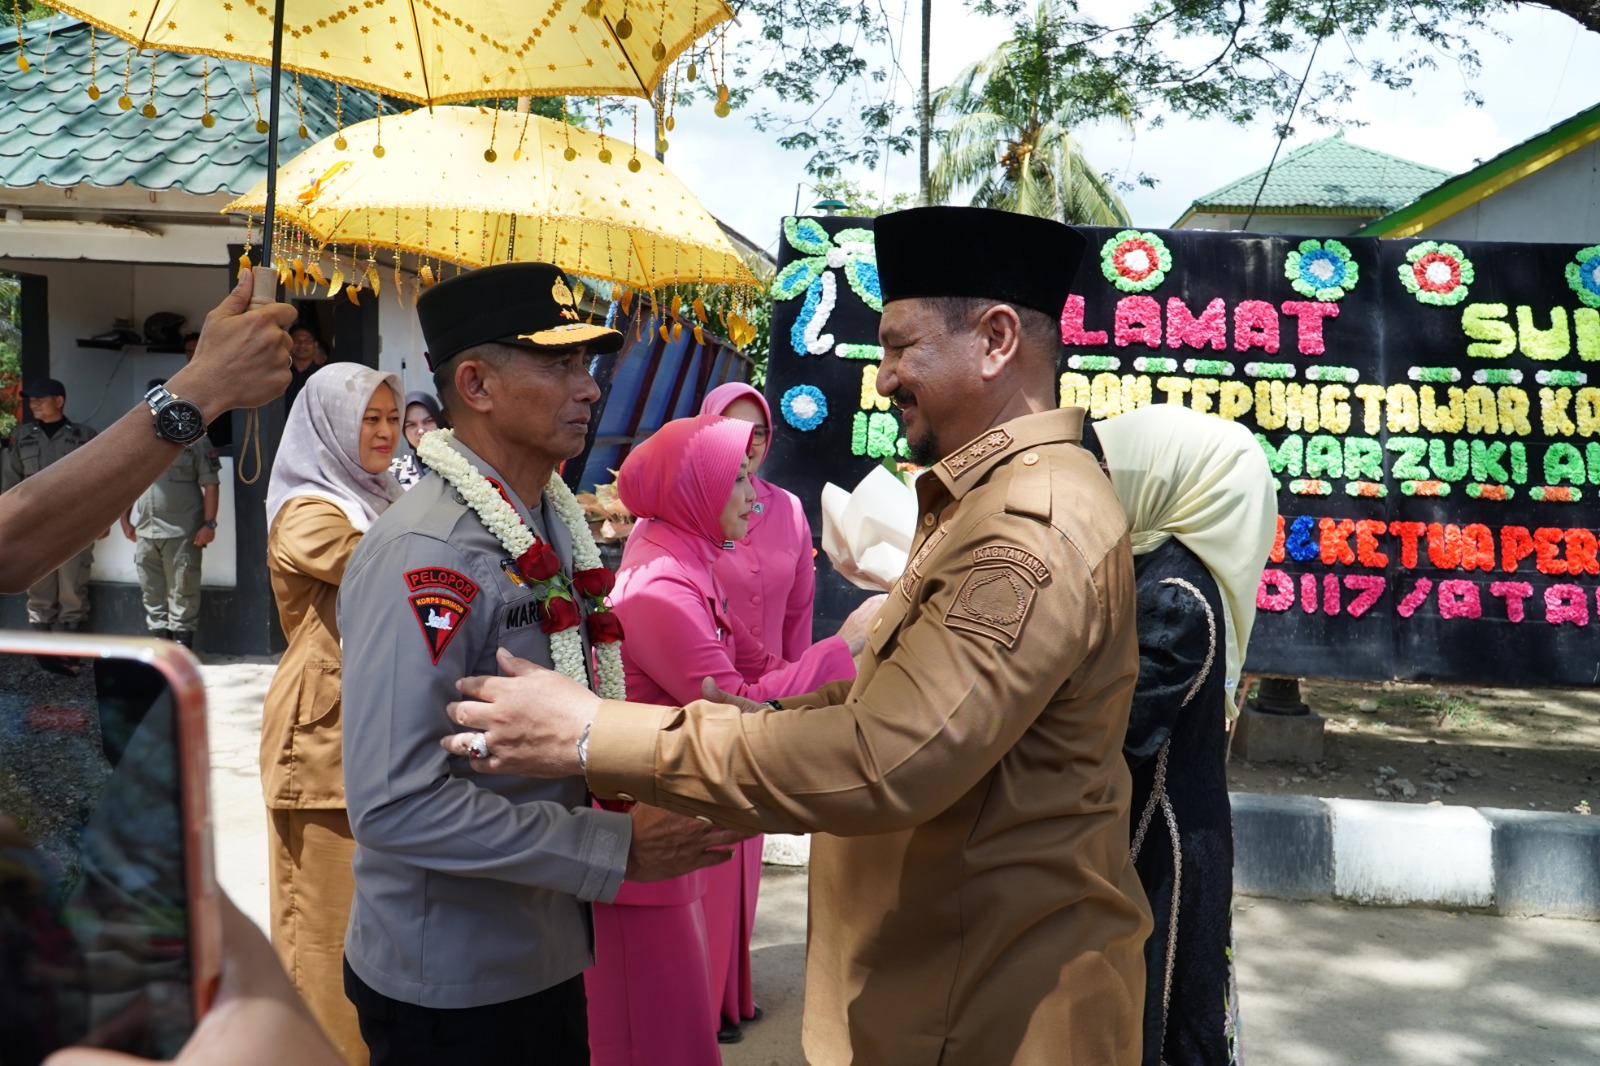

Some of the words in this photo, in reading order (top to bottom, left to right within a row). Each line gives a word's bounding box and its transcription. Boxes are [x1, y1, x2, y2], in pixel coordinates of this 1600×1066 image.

[1060, 293, 1339, 355] LAMAT
[851, 411, 911, 458] IR
[1252, 433, 1528, 485] MARZUKI
[1319, 517, 1495, 572] KETUA
[410, 571, 472, 597] PELOPOR
[416, 597, 440, 606] KORPS
[441, 598, 464, 614] BRIMOB
